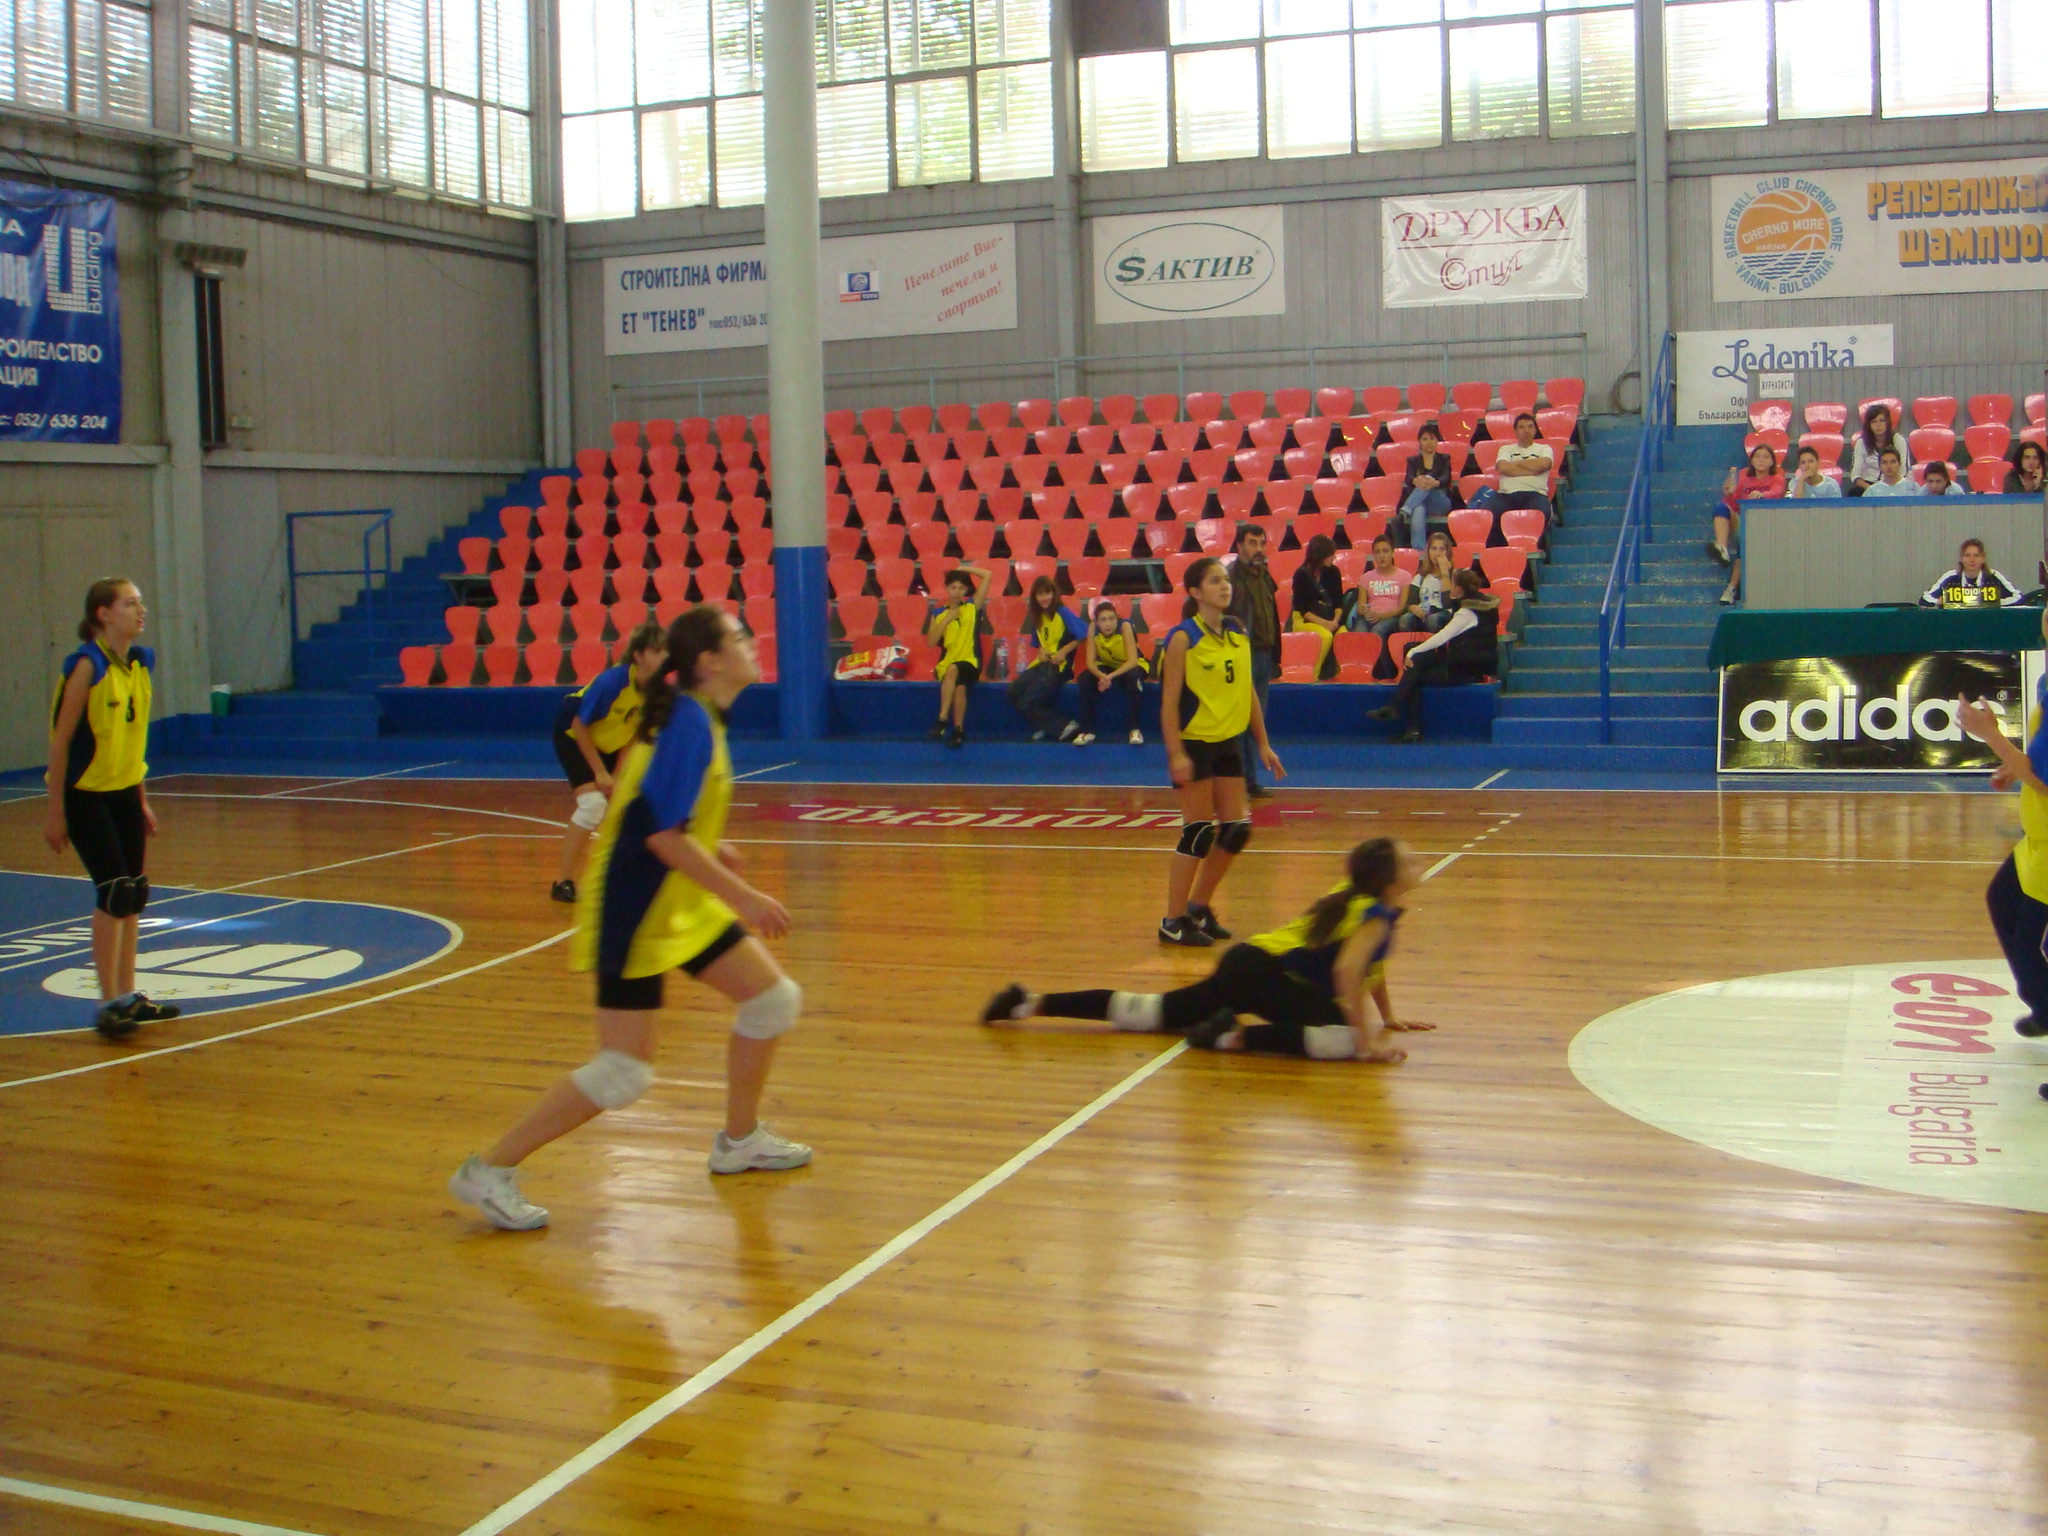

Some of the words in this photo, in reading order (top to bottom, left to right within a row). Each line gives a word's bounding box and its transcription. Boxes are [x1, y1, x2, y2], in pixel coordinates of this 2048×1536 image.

[1393, 204, 1568, 241] ДРУЖБА
[1723, 191, 1756, 260] BASKETBALL
[1756, 177, 1790, 194] CLUB
[1795, 179, 1837, 214] CHERNO
[1829, 216, 1844, 252] MORE
[1741, 221, 1789, 245] CHERNO
[1792, 218, 1825, 231] MORE
[621, 264, 711, 291] СТРОИТЕЛНА
[1736, 264, 1770, 293] VARNA
[1779, 259, 1834, 294] BULGARIA
[622, 312, 638, 334] ЕТ
[643, 307, 705, 333] "ТЕНЕВ"
[1712, 339, 1855, 384] Ledenika
[49, 414, 78, 428] 636
[80, 415, 108, 429] 204
[1947, 587, 1962, 602] 16
[1981, 587, 1997, 602] 13
[1224, 659, 1235, 684] 5
[1888, 1071, 2002, 1167] Bulgaria
